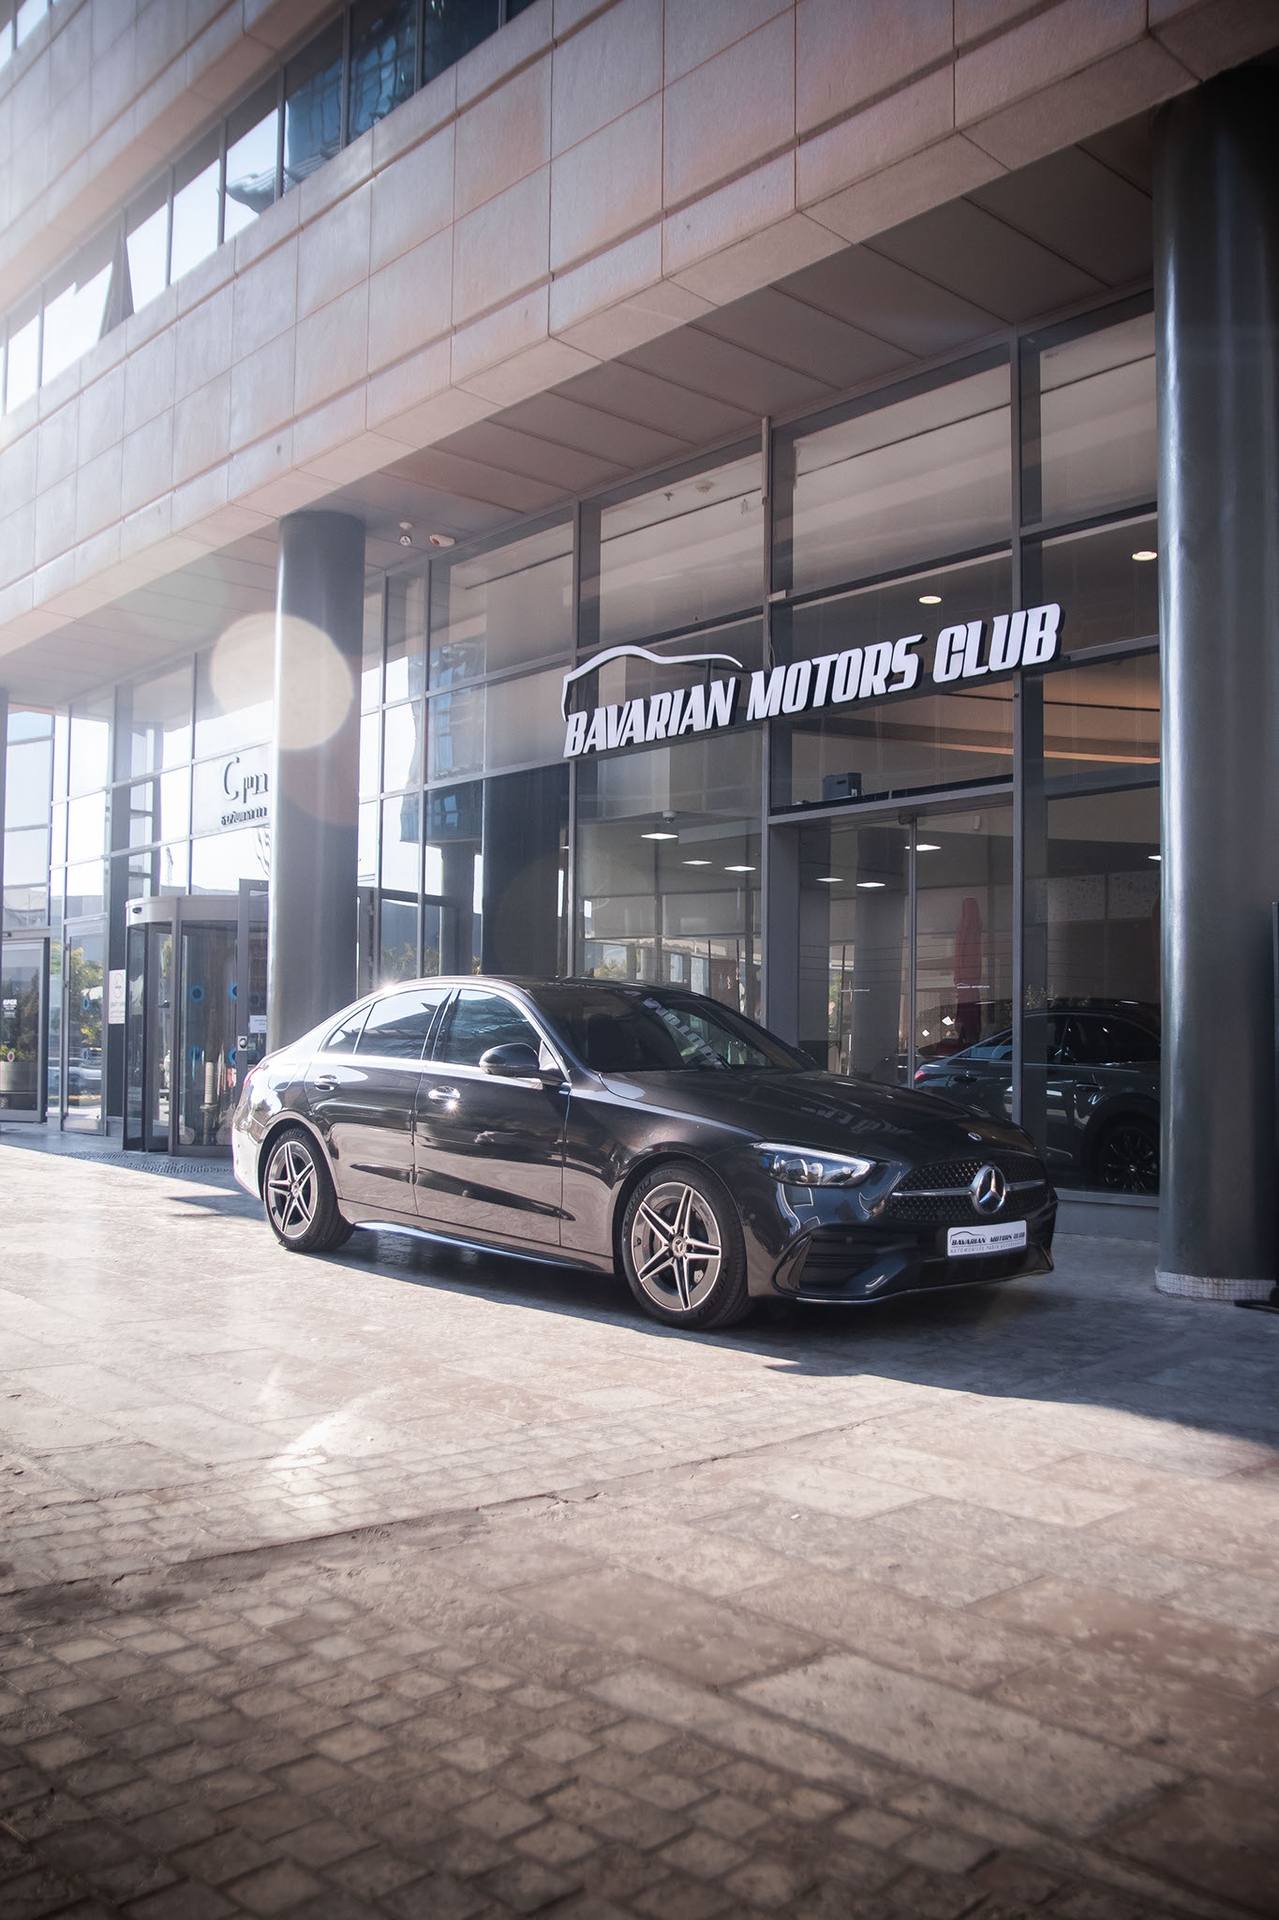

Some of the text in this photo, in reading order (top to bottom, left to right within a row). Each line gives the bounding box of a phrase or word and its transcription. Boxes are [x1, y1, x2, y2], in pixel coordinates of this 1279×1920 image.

[563, 603, 1061, 758] BAVARIAN MOTORS CLUB
[223, 756, 240, 801] C
[990, 1234, 1012, 1242] MOTORS
